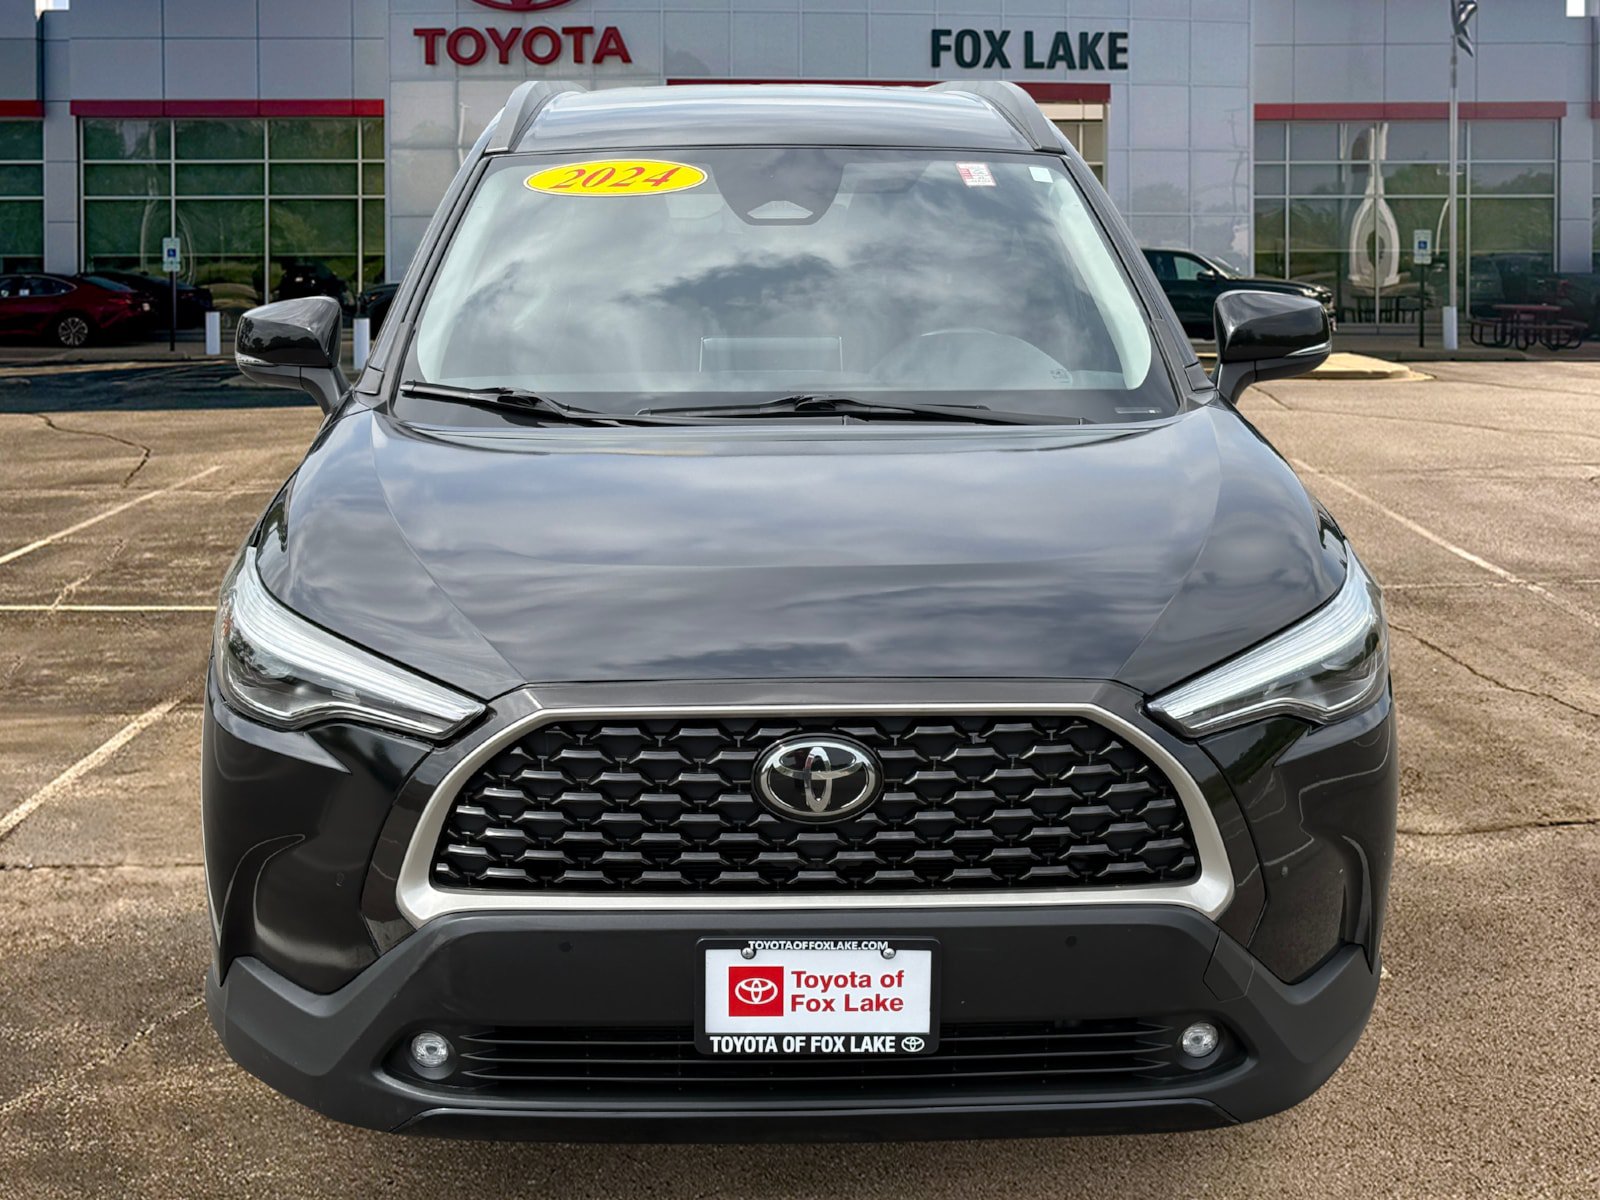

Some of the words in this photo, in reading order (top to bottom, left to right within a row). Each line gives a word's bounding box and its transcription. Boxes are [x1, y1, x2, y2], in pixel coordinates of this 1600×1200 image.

[414, 27, 631, 65] TOYOTA
[931, 29, 1011, 69] FOX
[1024, 30, 1128, 70] LAKE
[550, 166, 681, 190] 2024
[748, 940, 889, 951] TOYOTAOFFOXLAKE.COM
[791, 970, 872, 993] Toyota
[880, 970, 904, 988] of
[791, 994, 836, 1012] Fox
[844, 994, 904, 1012] Lake
[710, 1036, 778, 1053] TOYOTA
[782, 1036, 806, 1053] OF
[810, 1036, 845, 1053] FOX
[850, 1036, 896, 1053] LAKE
